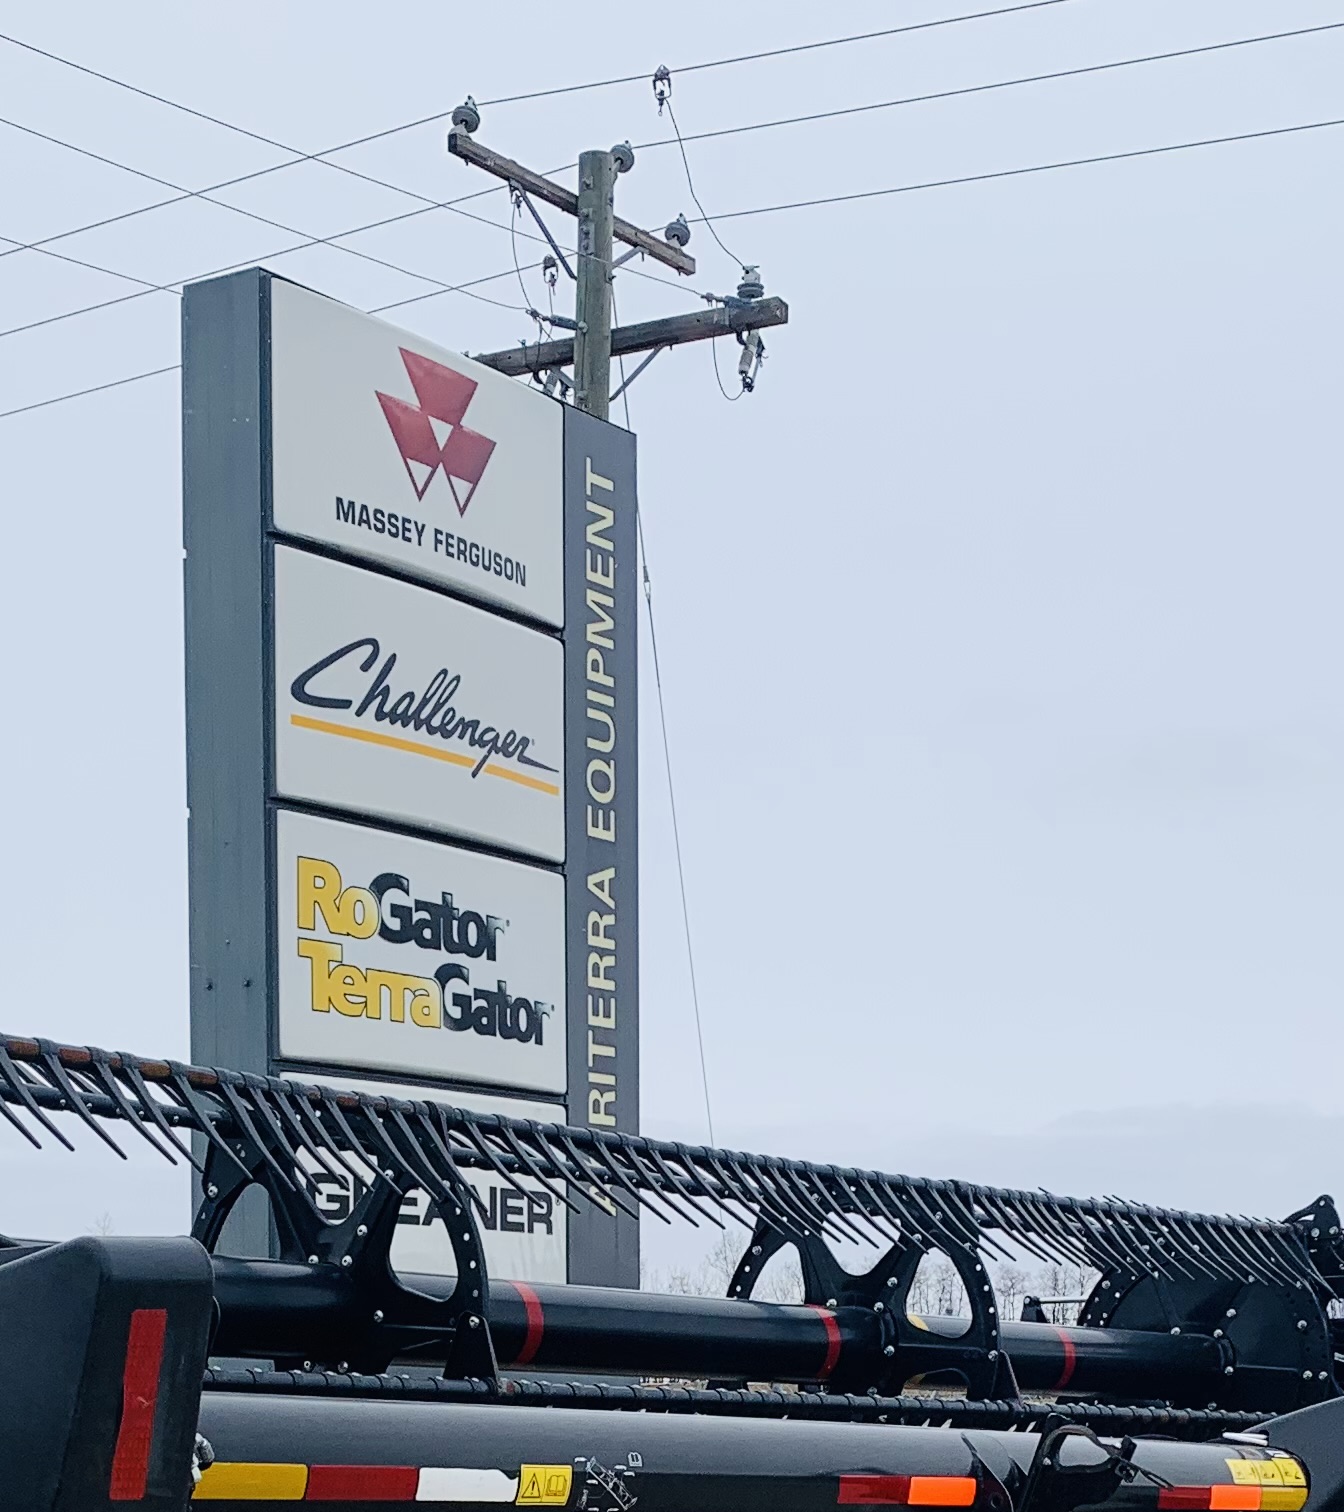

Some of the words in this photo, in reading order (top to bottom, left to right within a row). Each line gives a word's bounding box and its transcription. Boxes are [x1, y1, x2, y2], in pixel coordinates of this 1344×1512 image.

[335, 496, 426, 547] MASSEY
[433, 529, 526, 587] FERGUSON
[290, 637, 560, 777] Challenger
[585, 456, 617, 843] EQUIPMENT
[297, 856, 505, 961] RoGator
[297, 937, 552, 1046] TerraGator
[587, 866, 617, 1218] ARITERRA
